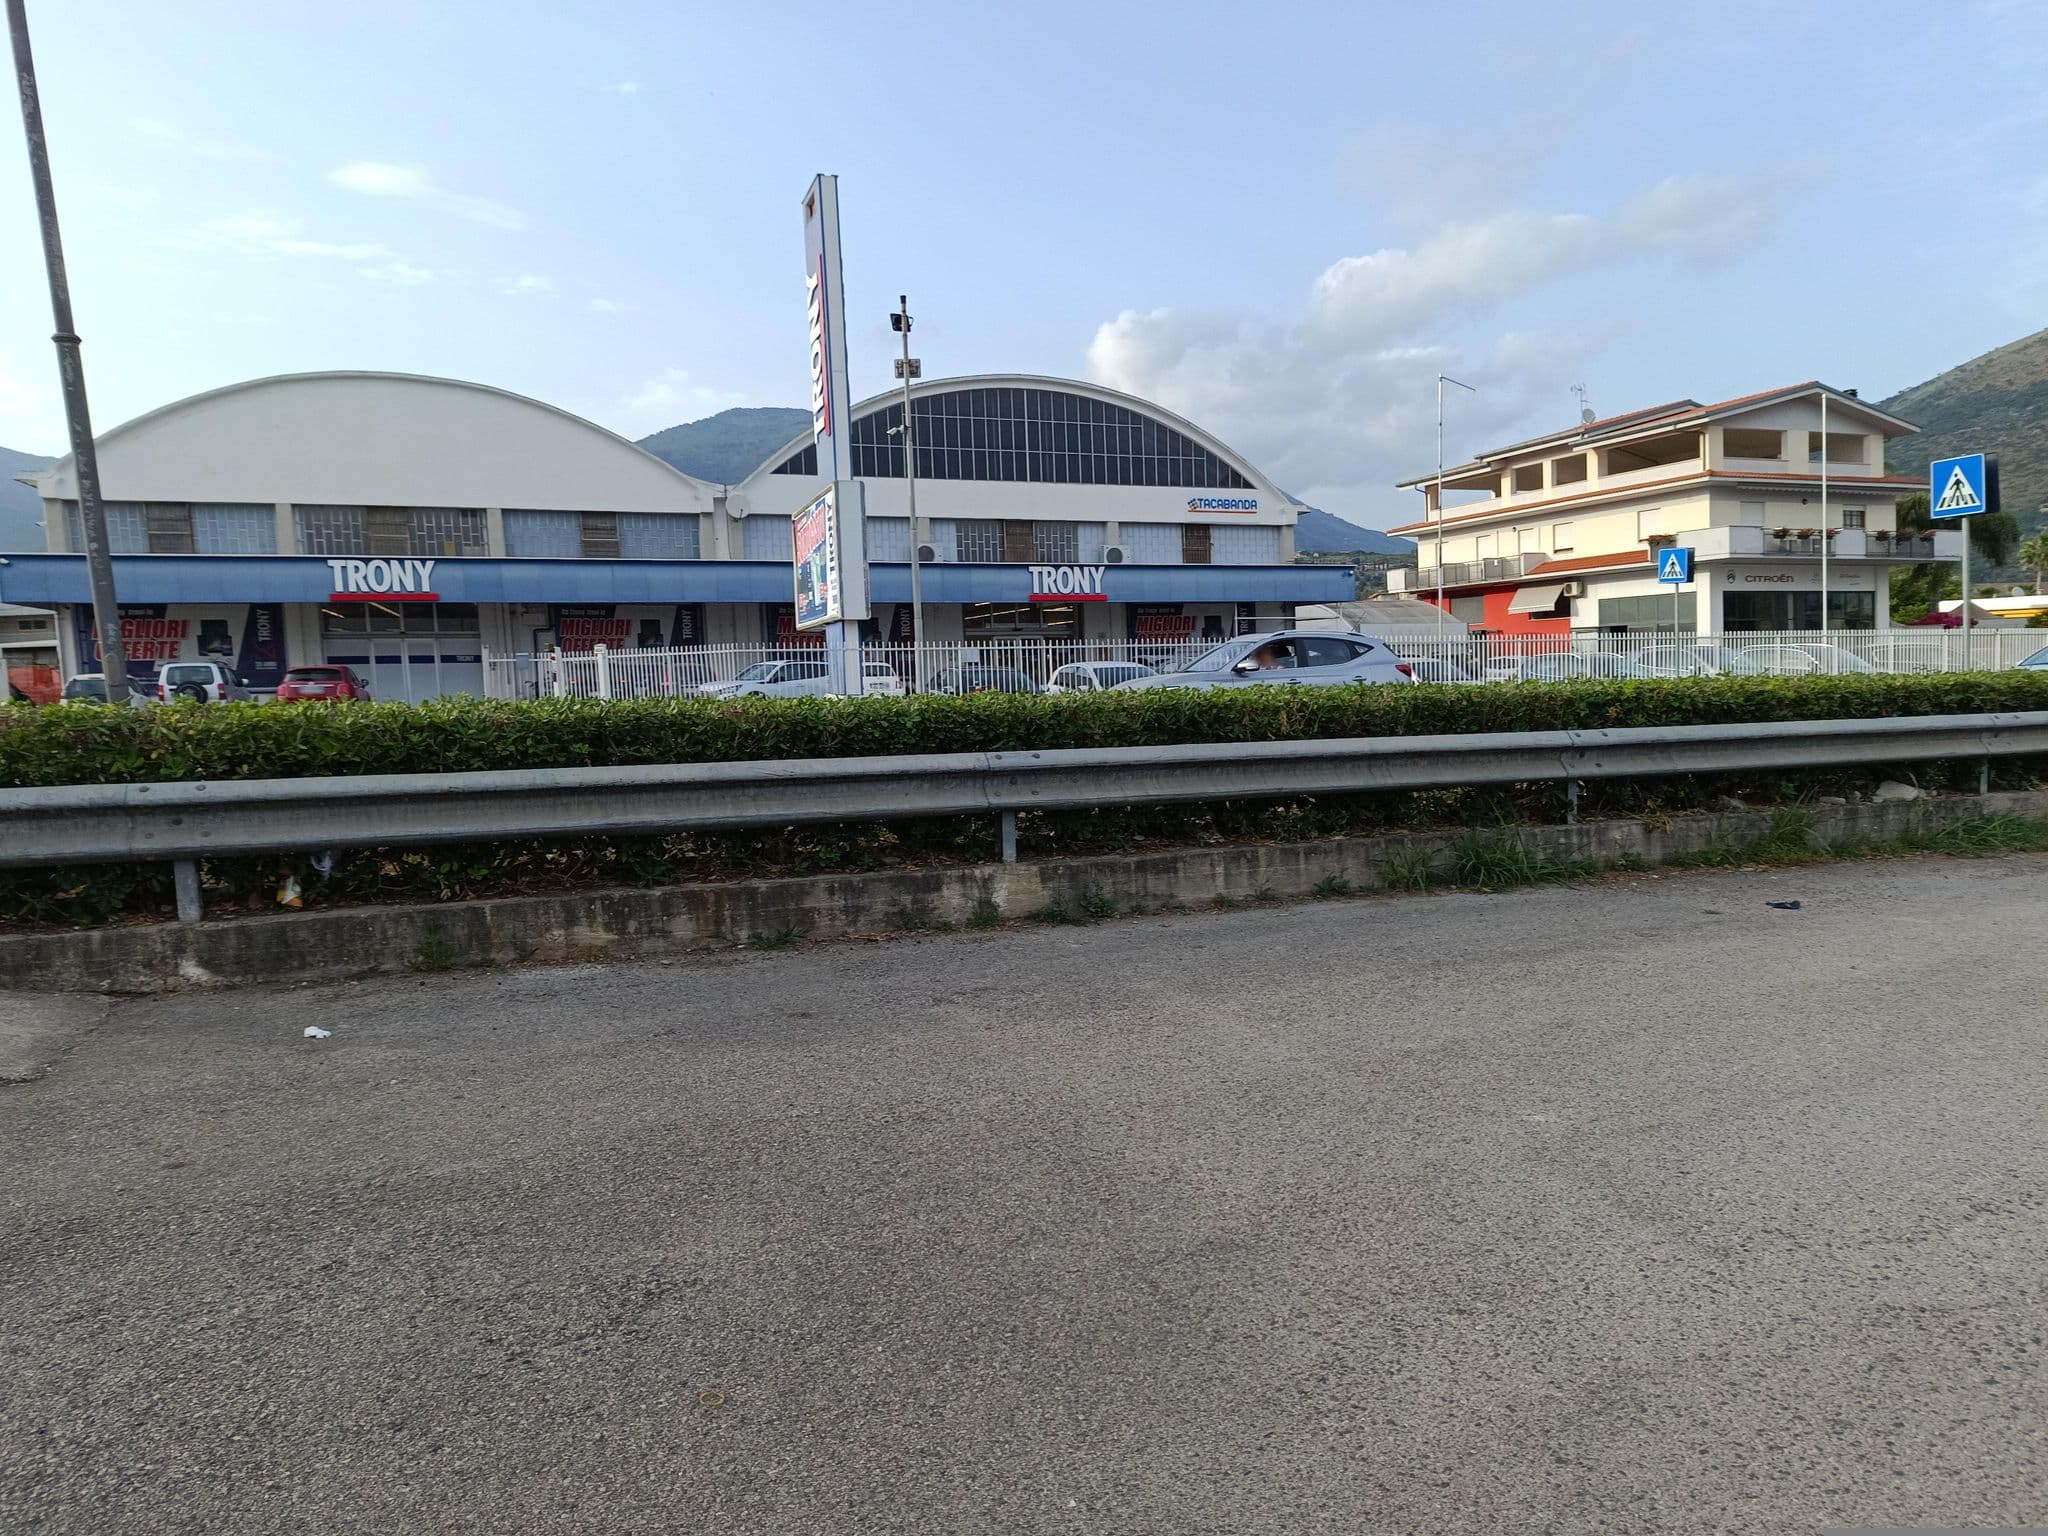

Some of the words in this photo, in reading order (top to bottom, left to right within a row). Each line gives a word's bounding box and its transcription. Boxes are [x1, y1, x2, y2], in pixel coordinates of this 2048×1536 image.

[806, 272, 824, 444] TRONY
[1197, 498, 1258, 510] TACABANDA
[327, 559, 435, 593] TRONY
[1028, 566, 1105, 594] TRONY
[256, 609, 272, 641] TRONY
[683, 610, 693, 639] TRONY
[900, 608, 912, 637] TRONY
